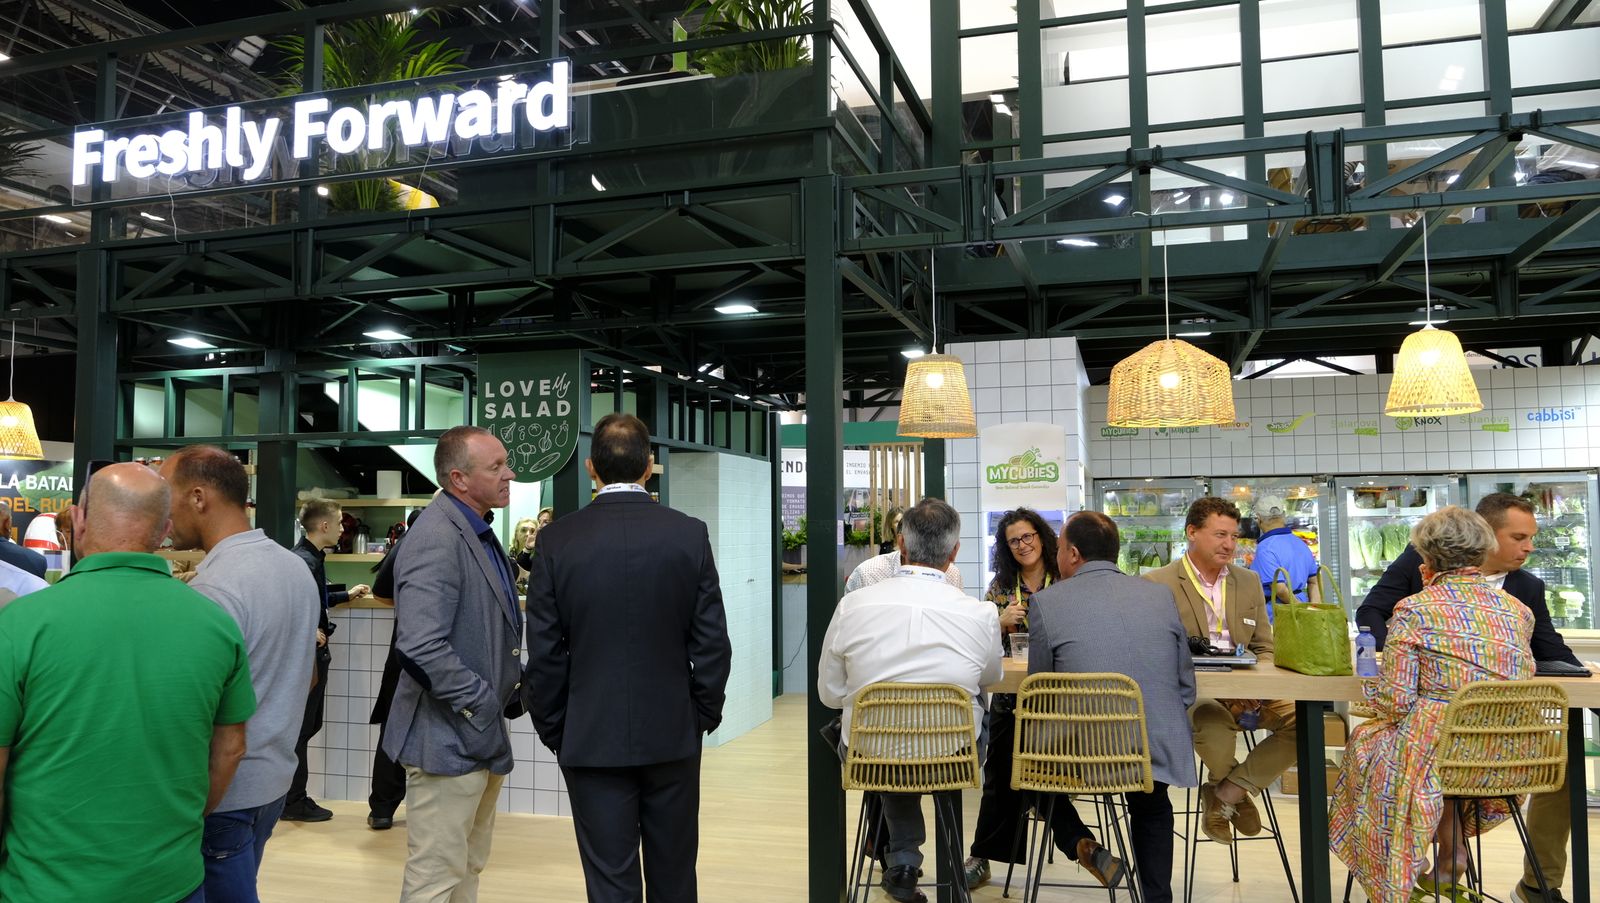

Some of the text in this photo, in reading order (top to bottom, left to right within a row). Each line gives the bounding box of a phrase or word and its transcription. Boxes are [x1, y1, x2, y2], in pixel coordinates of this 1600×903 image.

[72, 60, 568, 186] Freshly Forward
[484, 372, 571, 399] LOVE My
[484, 400, 571, 420] SALAD
[1527, 408, 1576, 422] cabbisi
[1414, 415, 1442, 427] KNOX
[0, 473, 20, 490] LA
